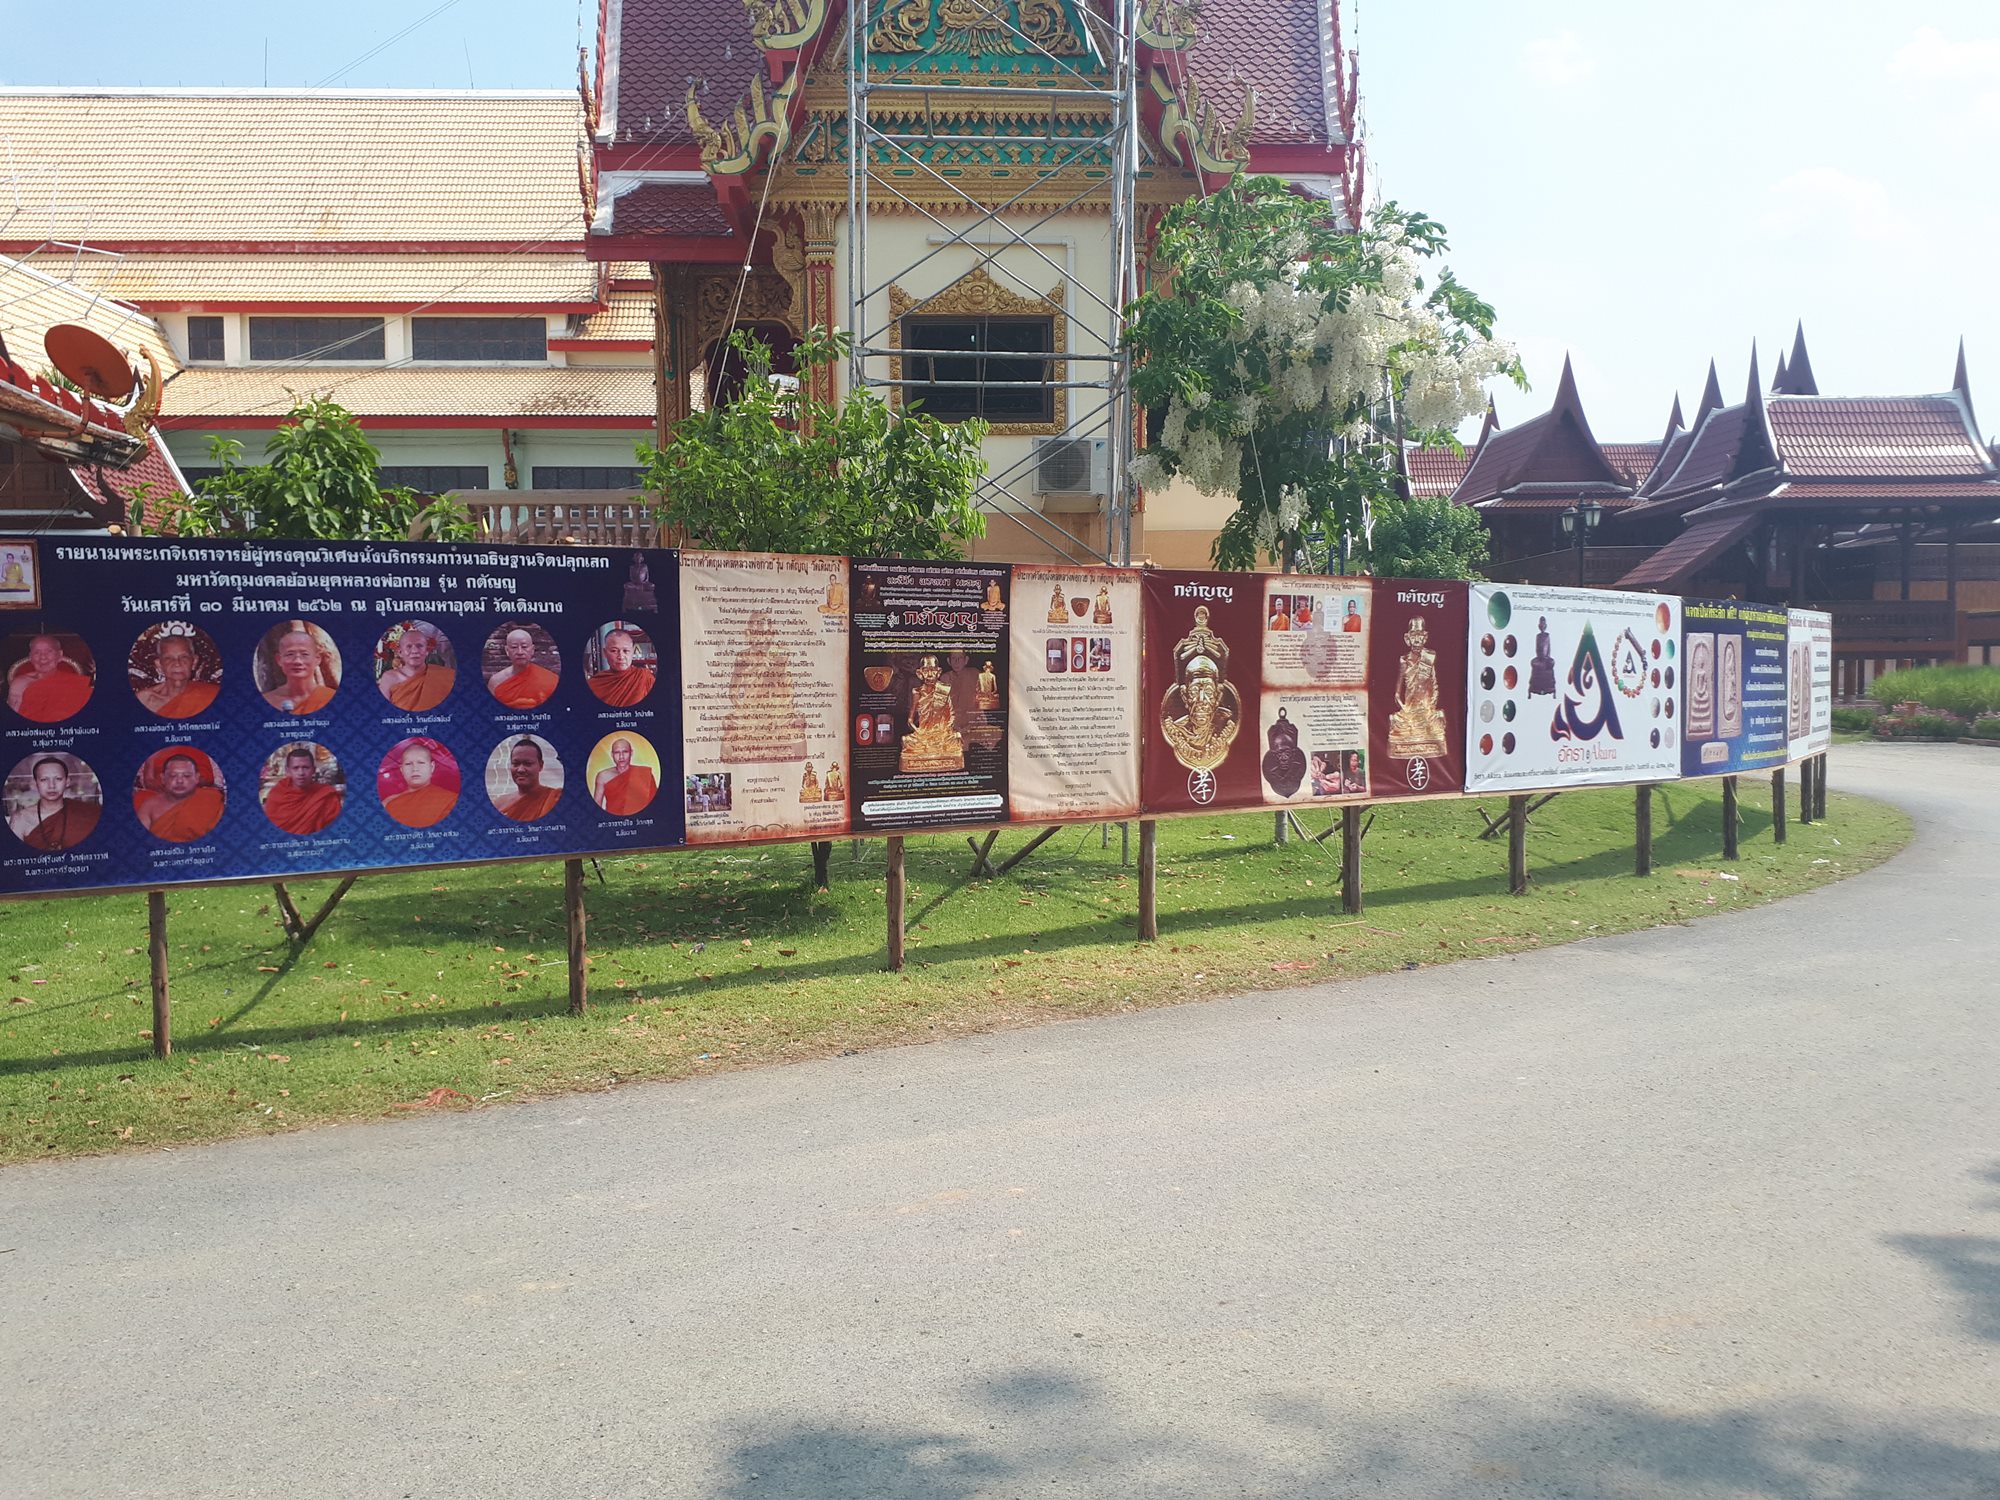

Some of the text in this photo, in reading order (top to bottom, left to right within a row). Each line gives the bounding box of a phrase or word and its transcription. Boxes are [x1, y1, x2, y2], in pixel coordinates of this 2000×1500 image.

[176, 571, 517, 594] มหาวัตถุมงคลย้อนยุคหลวงพ่อกวย รุ่น กตัญญู
[1173, 581, 1234, 604] กตัญญู
[121, 594, 563, 616] วันเสาร์ที่ ๓๐ มีนาคม ๒๕๖๒ ณ อุโบสถมหาอุตม์ วัดเดิมบาง
[1397, 588, 1445, 608] กตัญญู
[903, 606, 978, 631] กตัญญู
[1191, 769, 1213, 801] 孝
